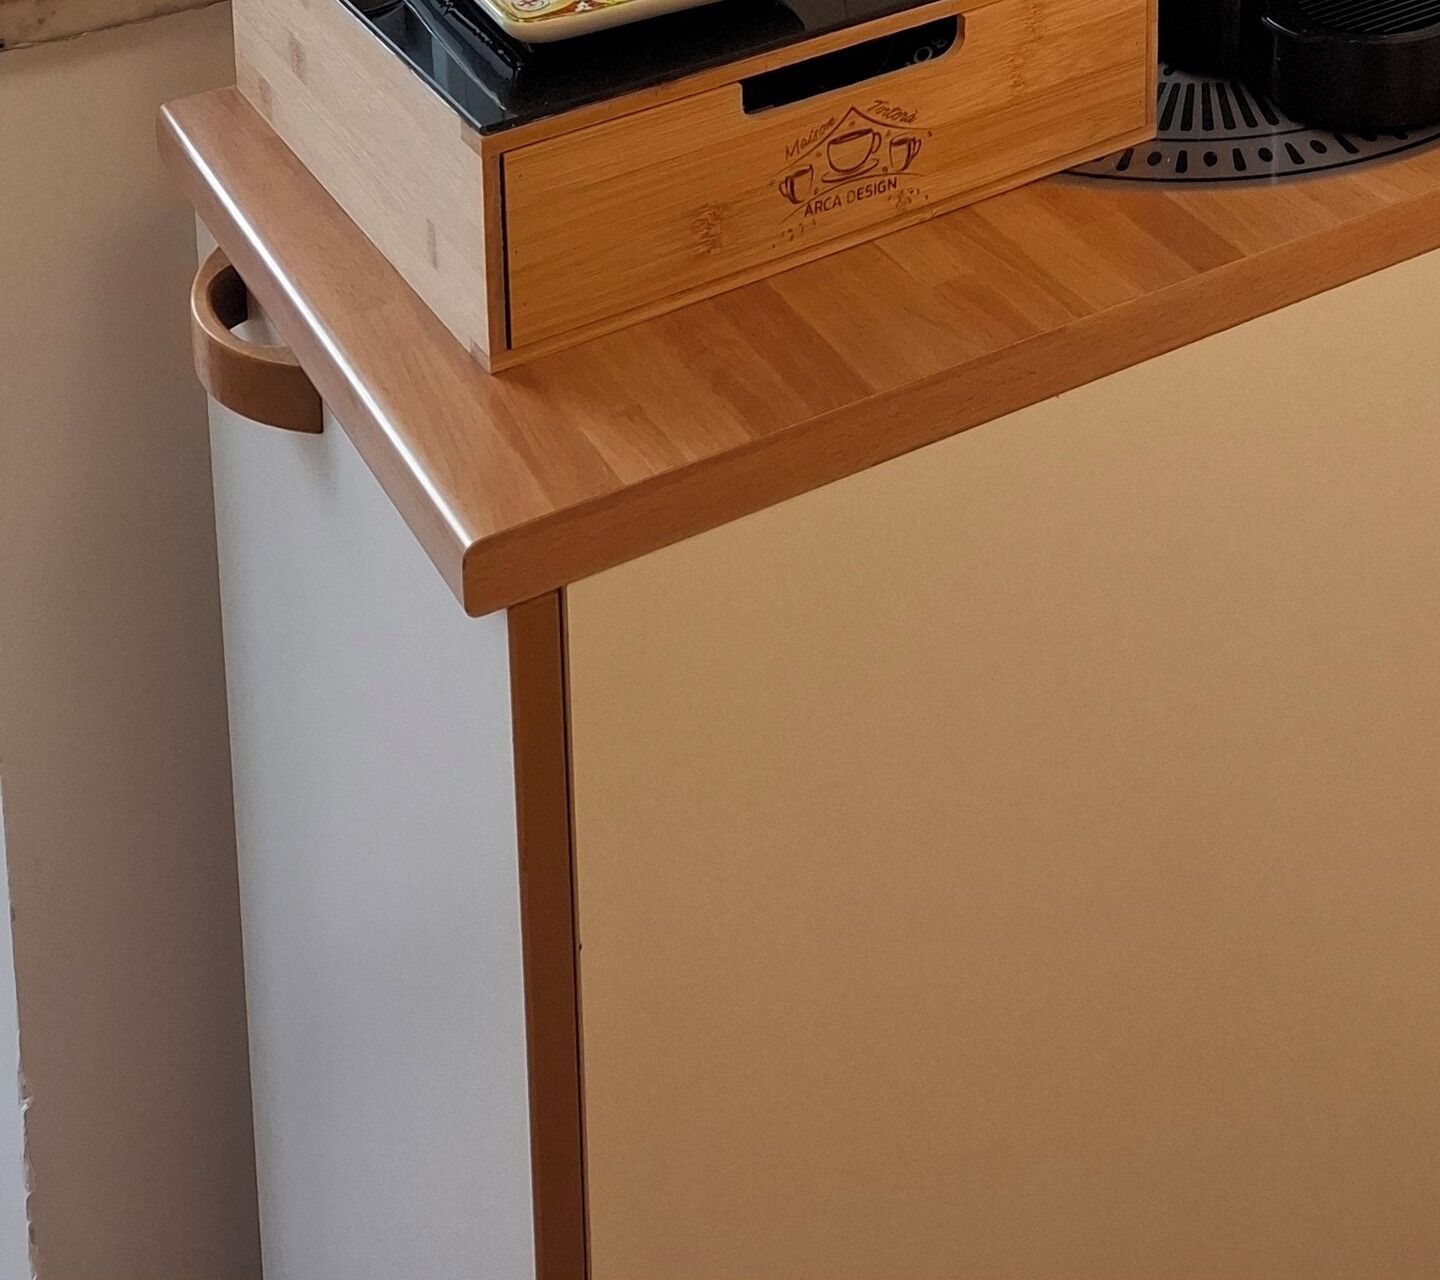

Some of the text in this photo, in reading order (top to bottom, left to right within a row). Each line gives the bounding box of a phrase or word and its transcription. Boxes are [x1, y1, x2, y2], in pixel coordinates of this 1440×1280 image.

[784, 116, 837, 161] Maison
[803, 177, 898, 217] ARCA DESIGN
